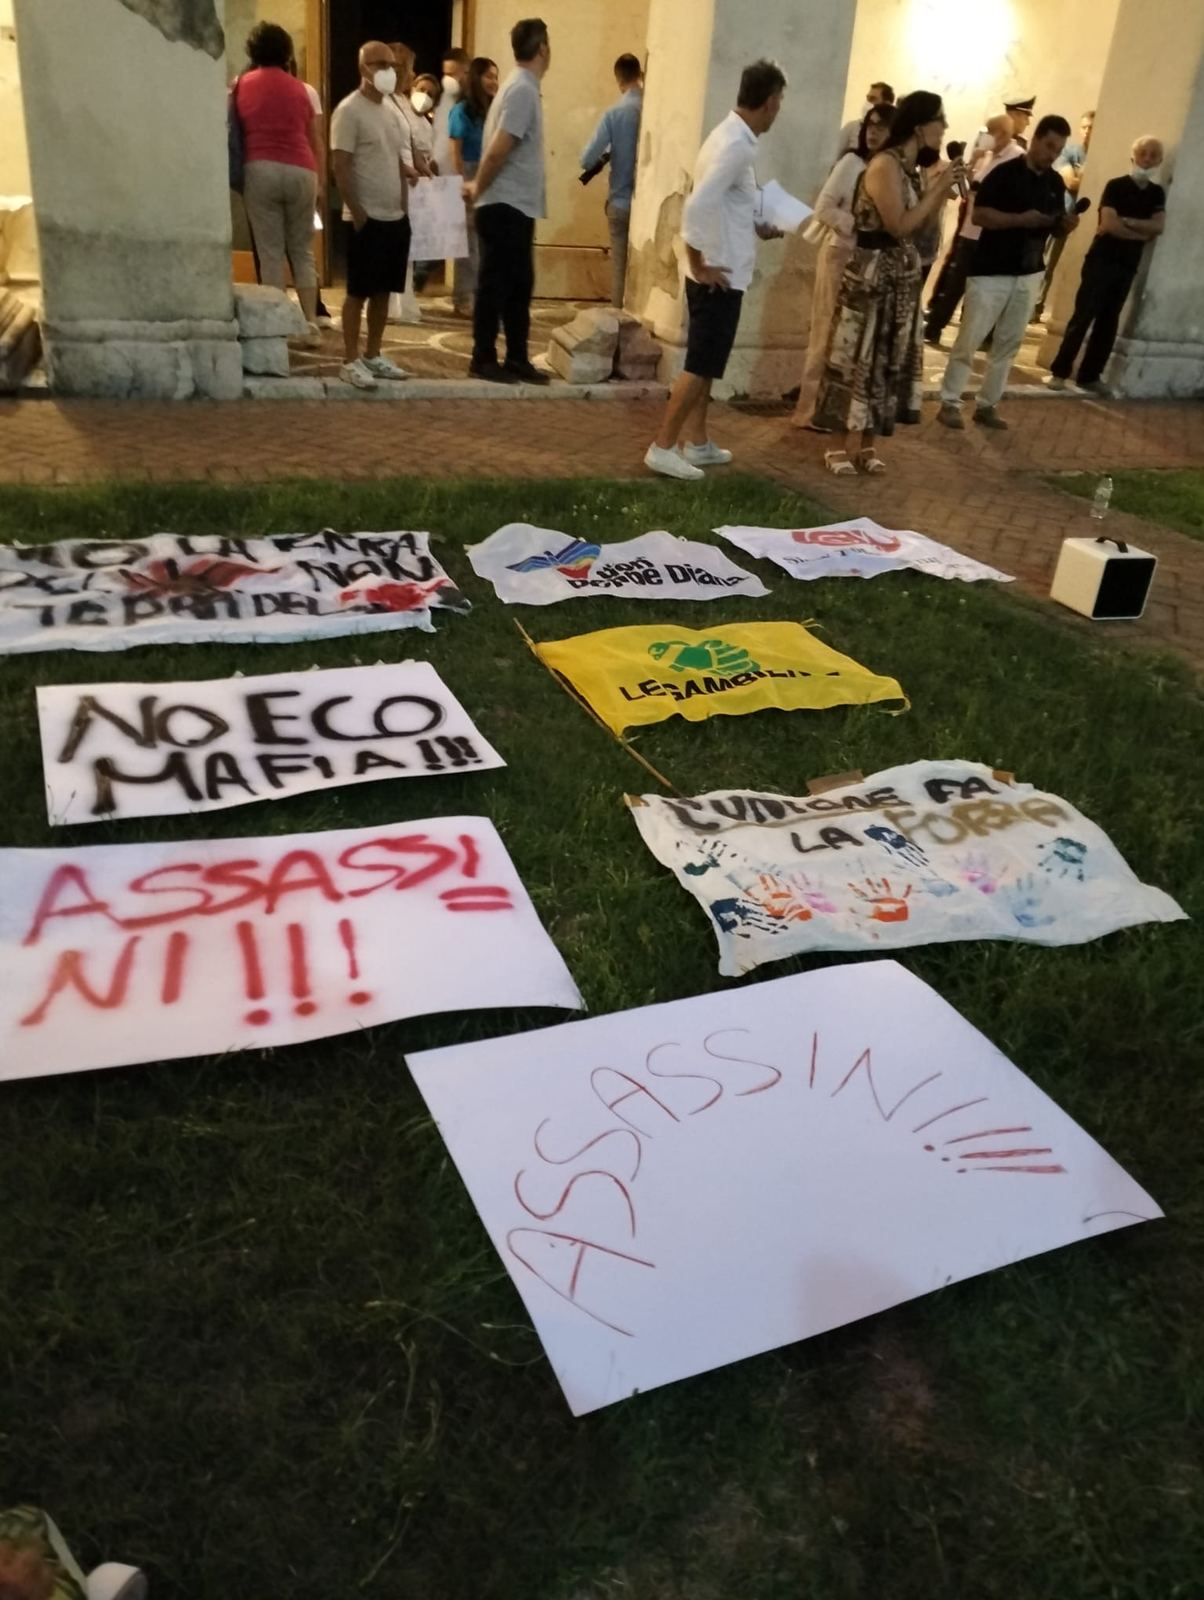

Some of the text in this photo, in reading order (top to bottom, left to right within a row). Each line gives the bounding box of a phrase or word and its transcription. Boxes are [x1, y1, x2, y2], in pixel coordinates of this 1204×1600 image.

[57, 689, 447, 764] NO ECO
[923, 776, 1000, 804] FA
[791, 826, 864, 854] LA
